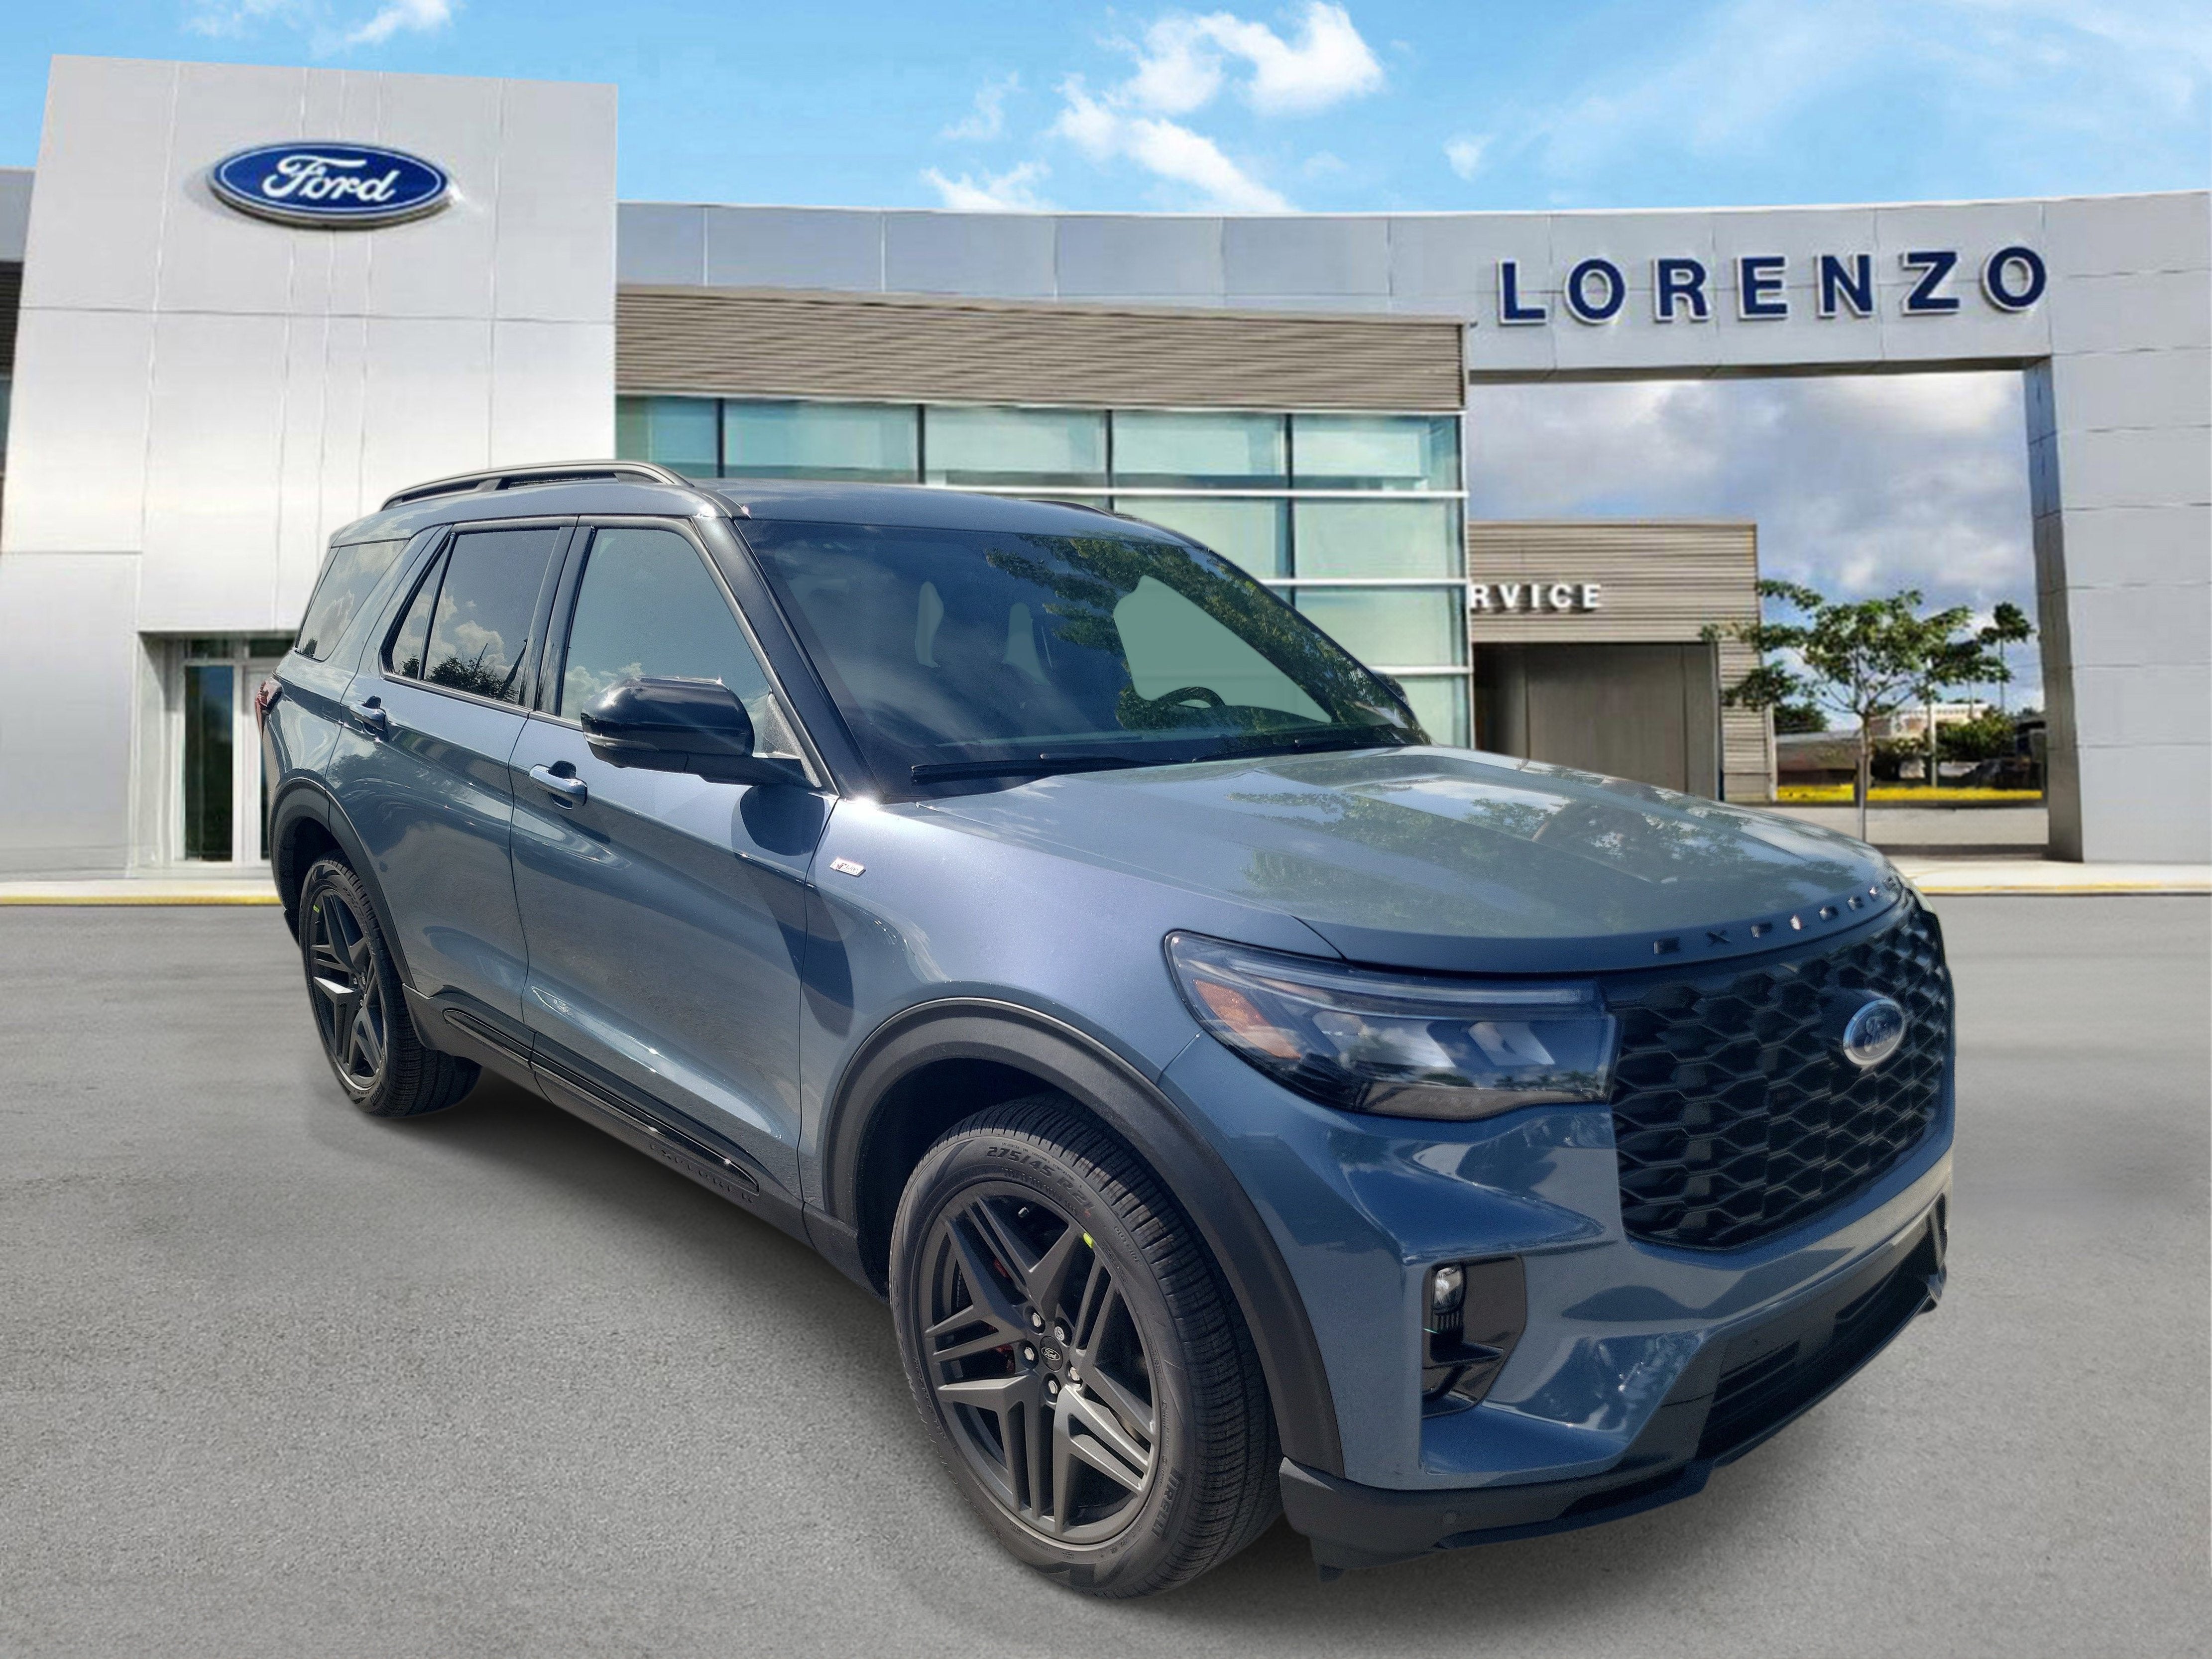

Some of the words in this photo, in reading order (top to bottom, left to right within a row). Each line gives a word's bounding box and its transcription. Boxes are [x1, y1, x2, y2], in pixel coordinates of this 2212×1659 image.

[262, 154, 400, 201] Ford
[1498, 245, 2047, 325] LORENZO
[1469, 583, 1602, 608] RVICE
[986, 1146, 1055, 1178] 275/45
[1044, 1348, 1057, 1359] Ford
